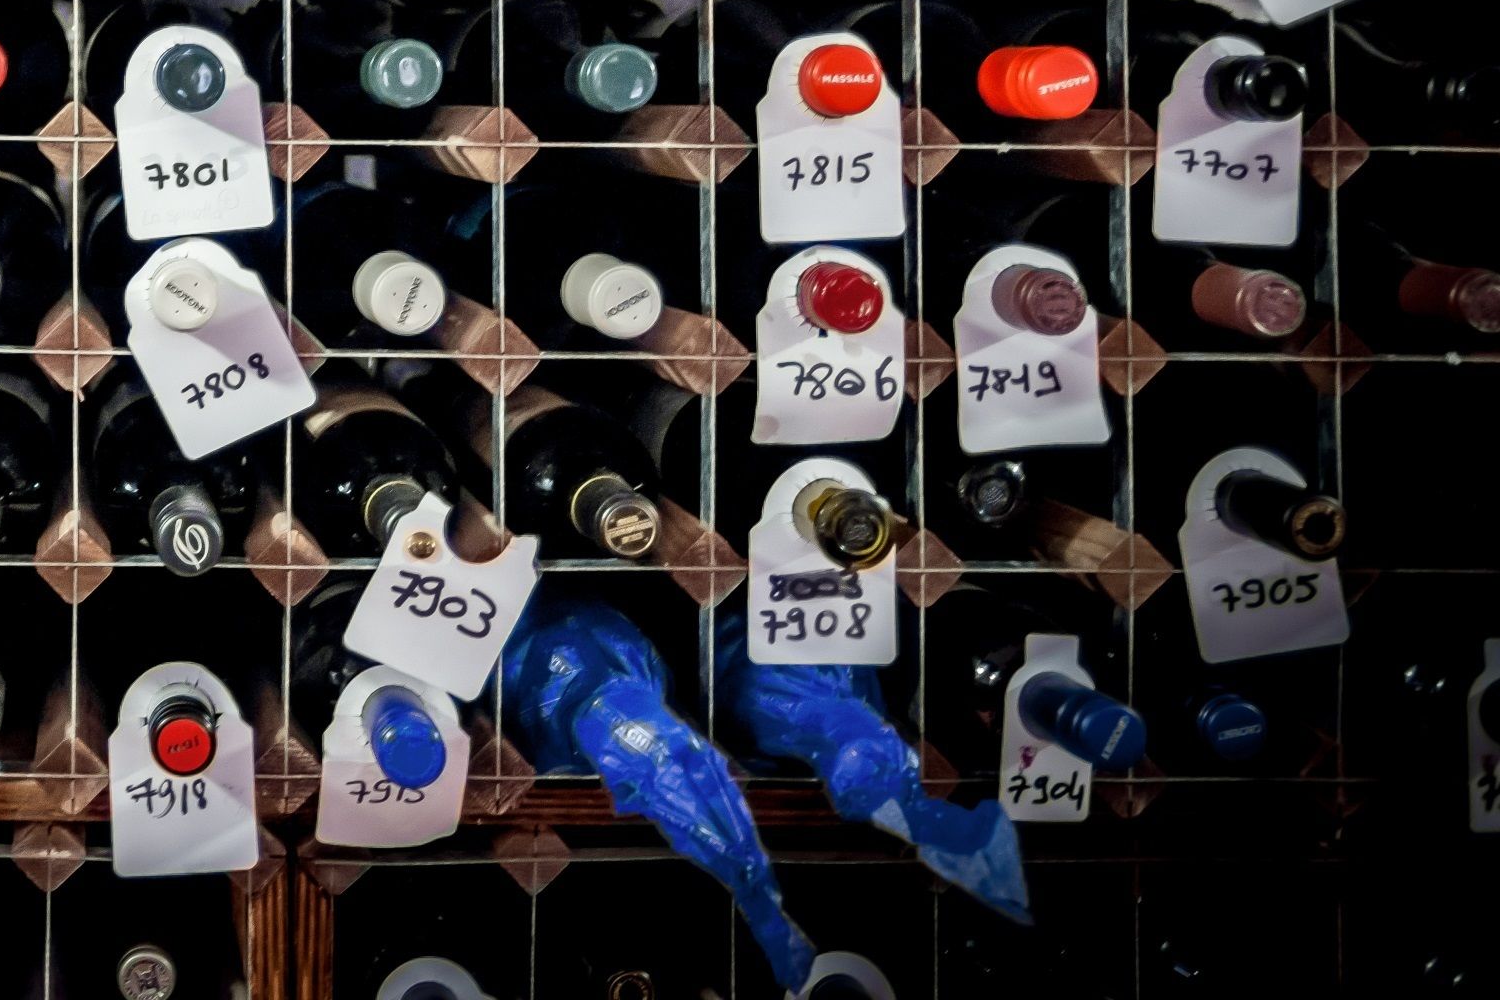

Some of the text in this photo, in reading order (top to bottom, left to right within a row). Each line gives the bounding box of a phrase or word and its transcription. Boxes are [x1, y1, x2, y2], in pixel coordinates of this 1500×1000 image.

[822, 73, 874, 84] MASSALE
[1038, 74, 1090, 95] MASSALE
[145, 158, 229, 190] 7801
[783, 152, 874, 190] 7815
[1175, 150, 1277, 182] 7707
[182, 354, 270, 409] 7808
[969, 361, 1061, 401] 7819
[391, 570, 496, 638] 7903
[1213, 574, 1318, 612] 7905
[759, 604, 872, 644] 7908
[126, 778, 207, 819] 7918
[1008, 774, 1085, 810] 7904
